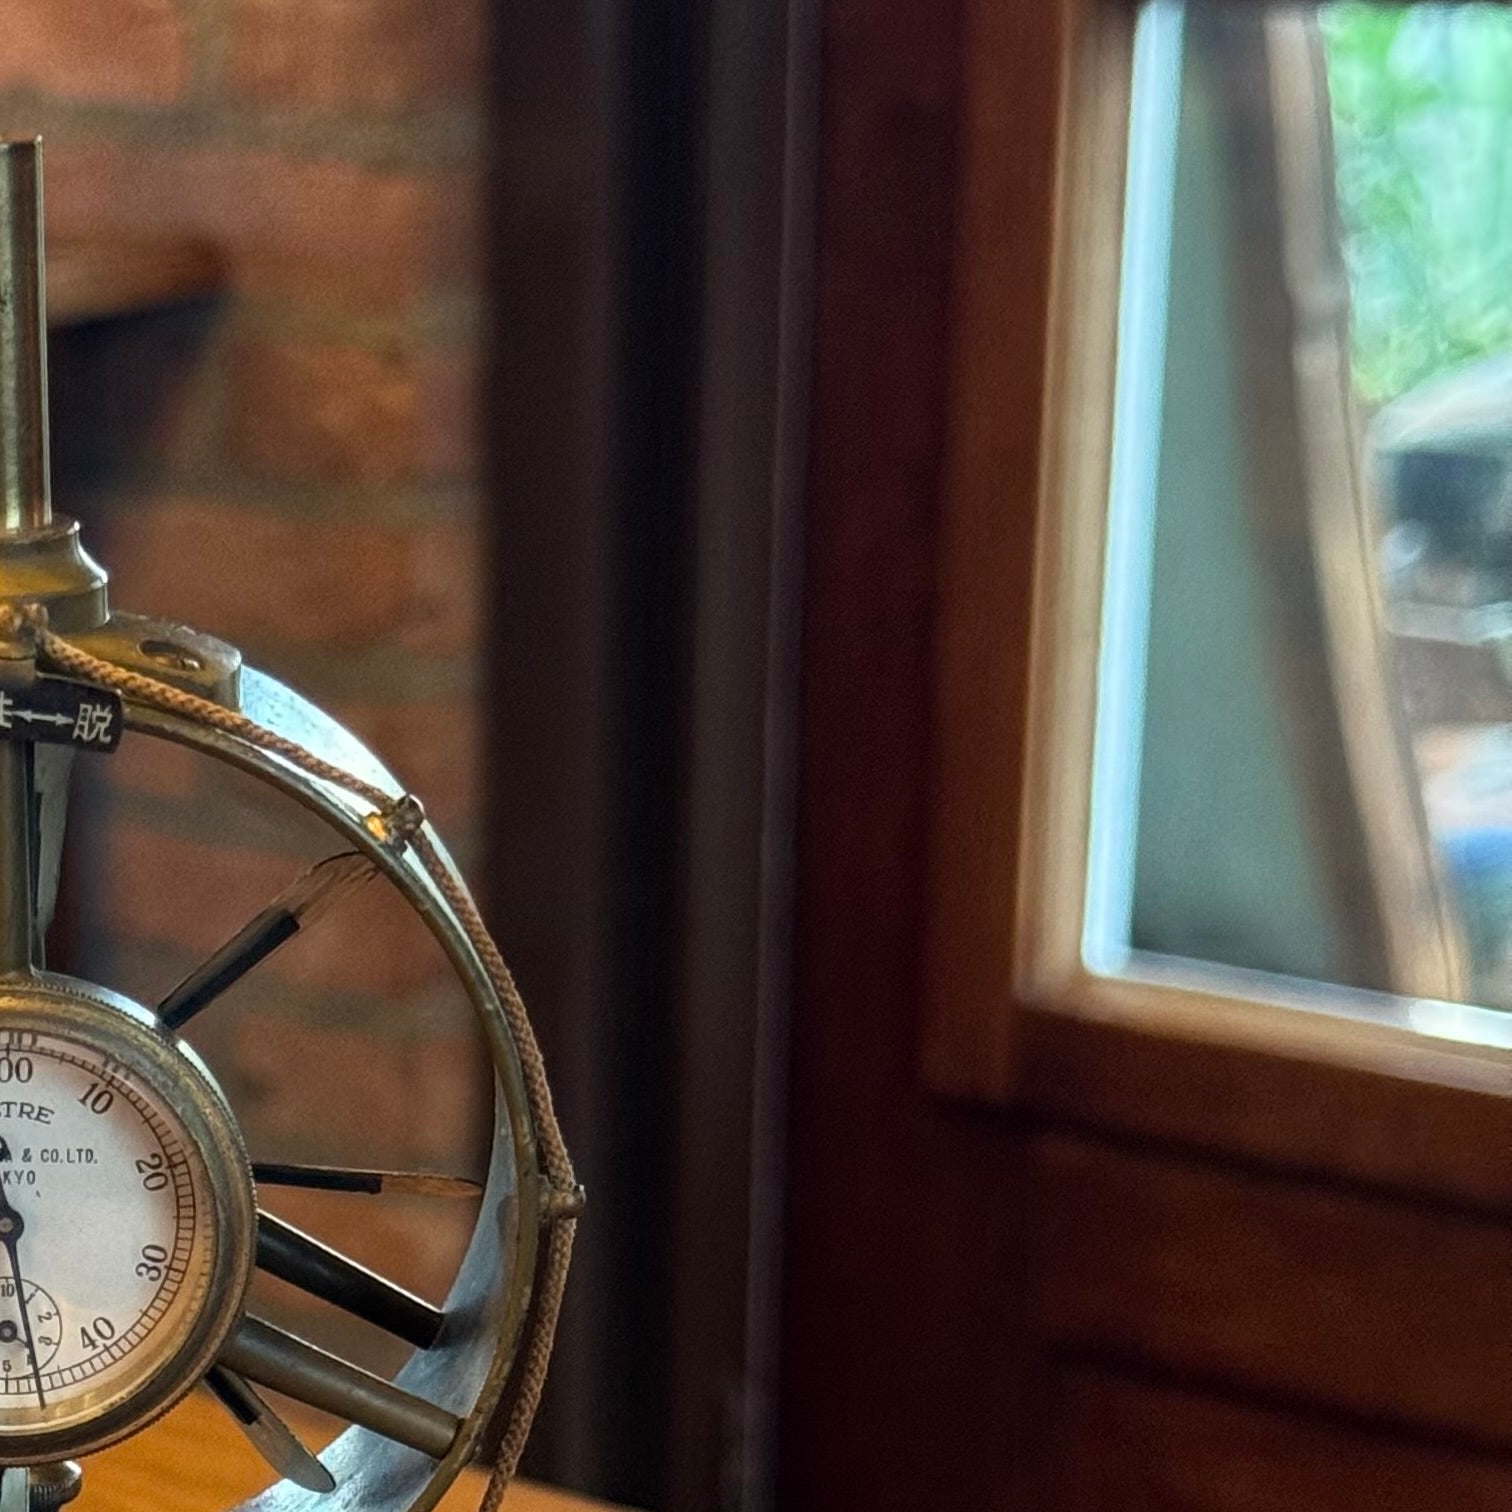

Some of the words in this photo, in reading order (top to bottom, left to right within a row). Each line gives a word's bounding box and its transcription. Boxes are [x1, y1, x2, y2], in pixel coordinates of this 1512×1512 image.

[72, 703, 113, 743] 脱
[78, 1082, 114, 1114] 10
[22, 1148, 32, 1162] &
[135, 1152, 169, 1192] 20
[134, 1245, 168, 1282] 30
[0, 1284, 14, 1297] 10
[37, 1312, 52, 1323] 2
[79, 1316, 116, 1352] 40
[2, 1360, 11, 1373] 5
